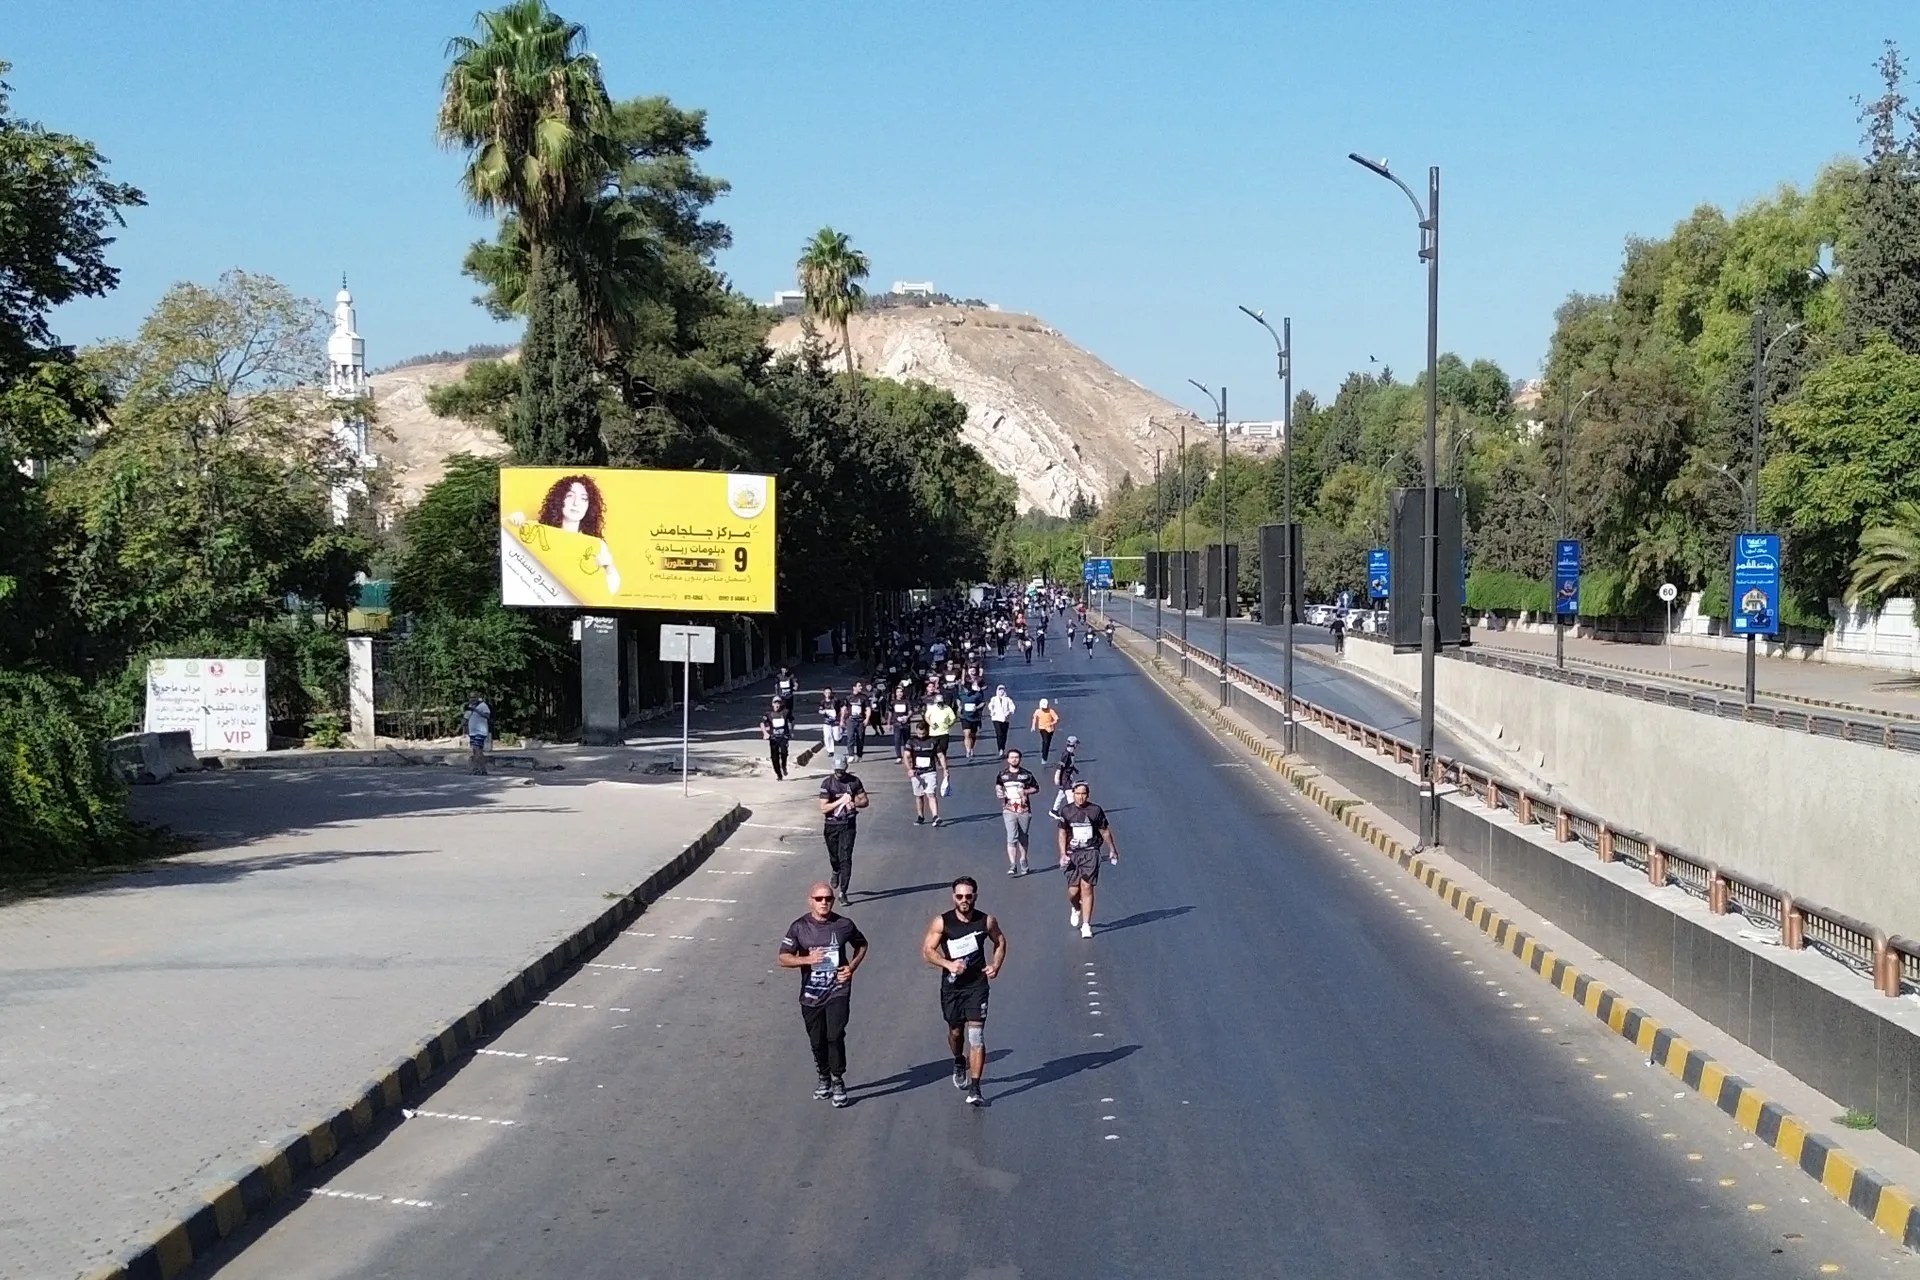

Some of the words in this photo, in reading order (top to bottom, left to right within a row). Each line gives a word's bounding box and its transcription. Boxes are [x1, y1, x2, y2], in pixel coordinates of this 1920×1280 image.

[650, 523, 713, 540] جلجامش
[716, 526, 751, 540] مركز
[690, 545, 725, 557] دبلومات
[664, 558, 698, 570] البكالوريا
[698, 561, 717, 570] بعد
[734, 546, 748, 573] 9
[533, 574, 560, 597] تخرج
[224, 731, 252, 744] VIP
